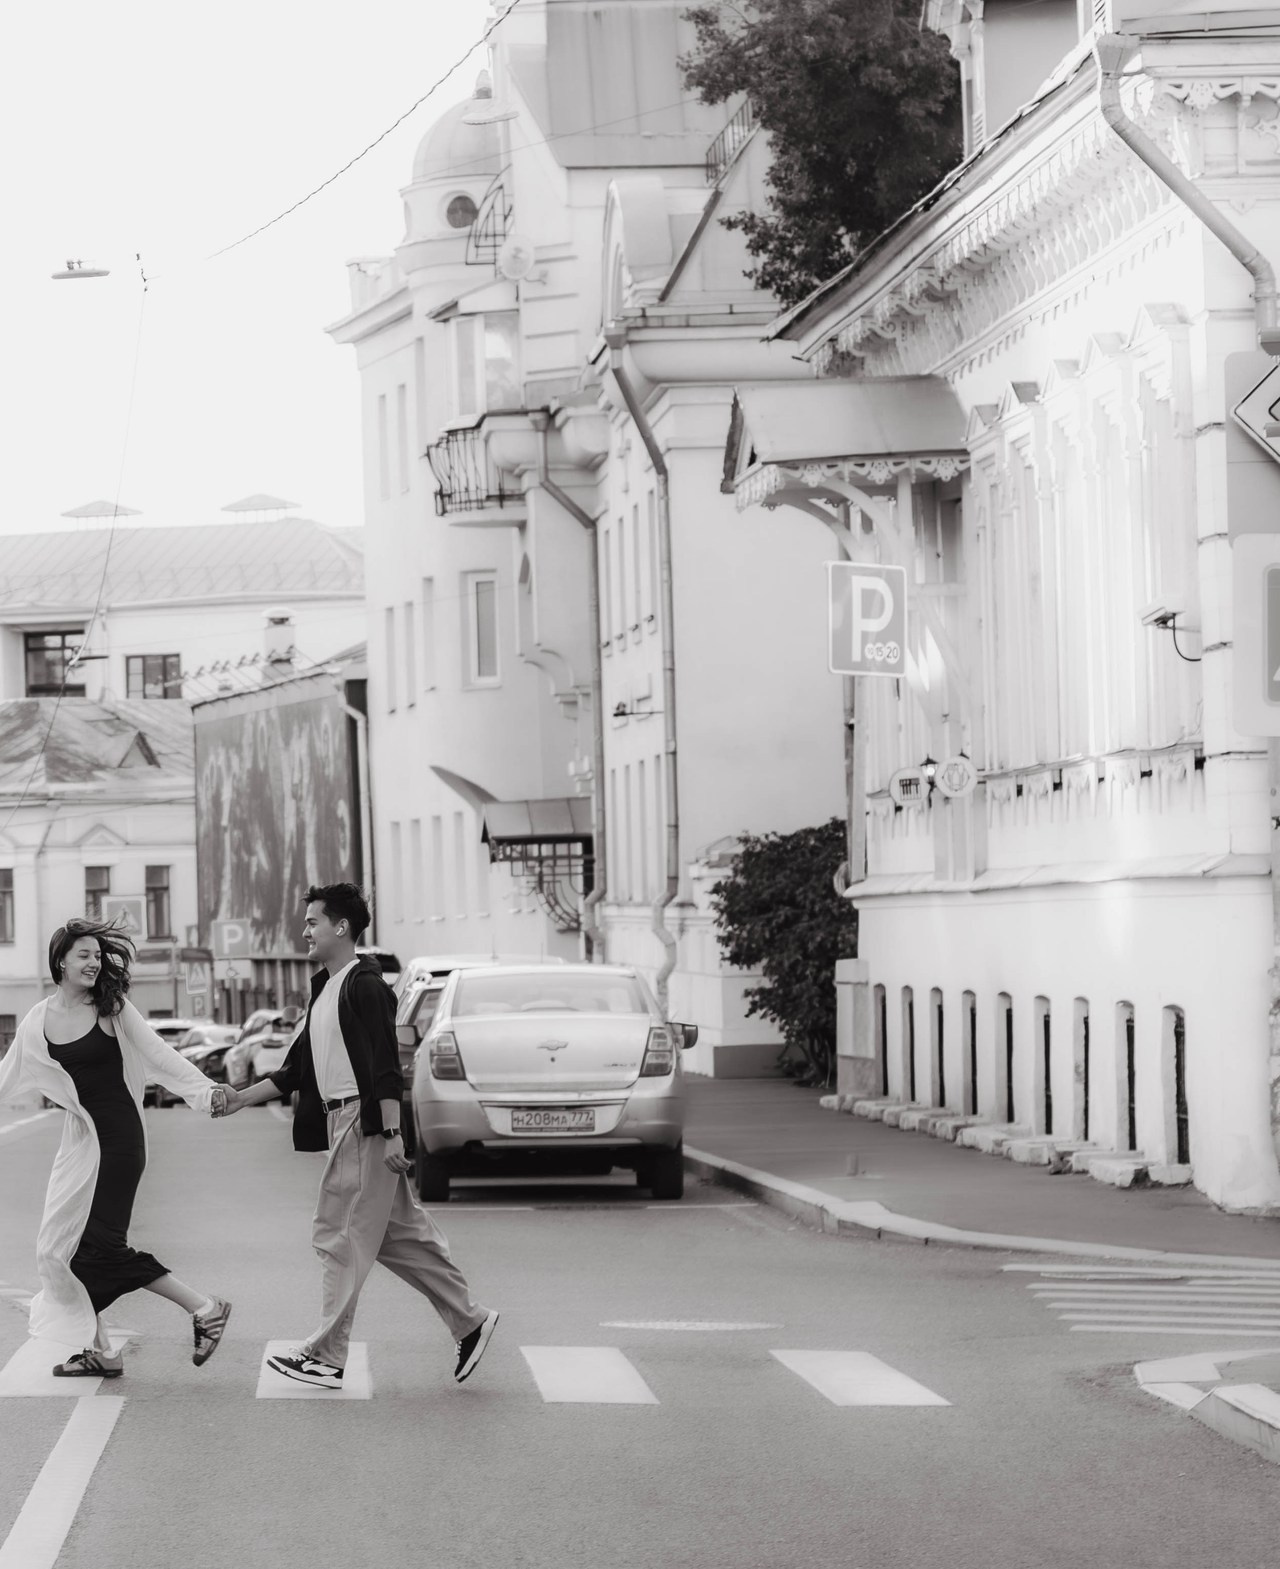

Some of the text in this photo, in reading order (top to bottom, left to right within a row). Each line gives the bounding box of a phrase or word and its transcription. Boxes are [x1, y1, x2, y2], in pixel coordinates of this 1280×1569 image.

[851, 575, 894, 662] P
[875, 646, 884, 657] 15
[886, 646, 899, 659] 20
[223, 924, 243, 954] P
